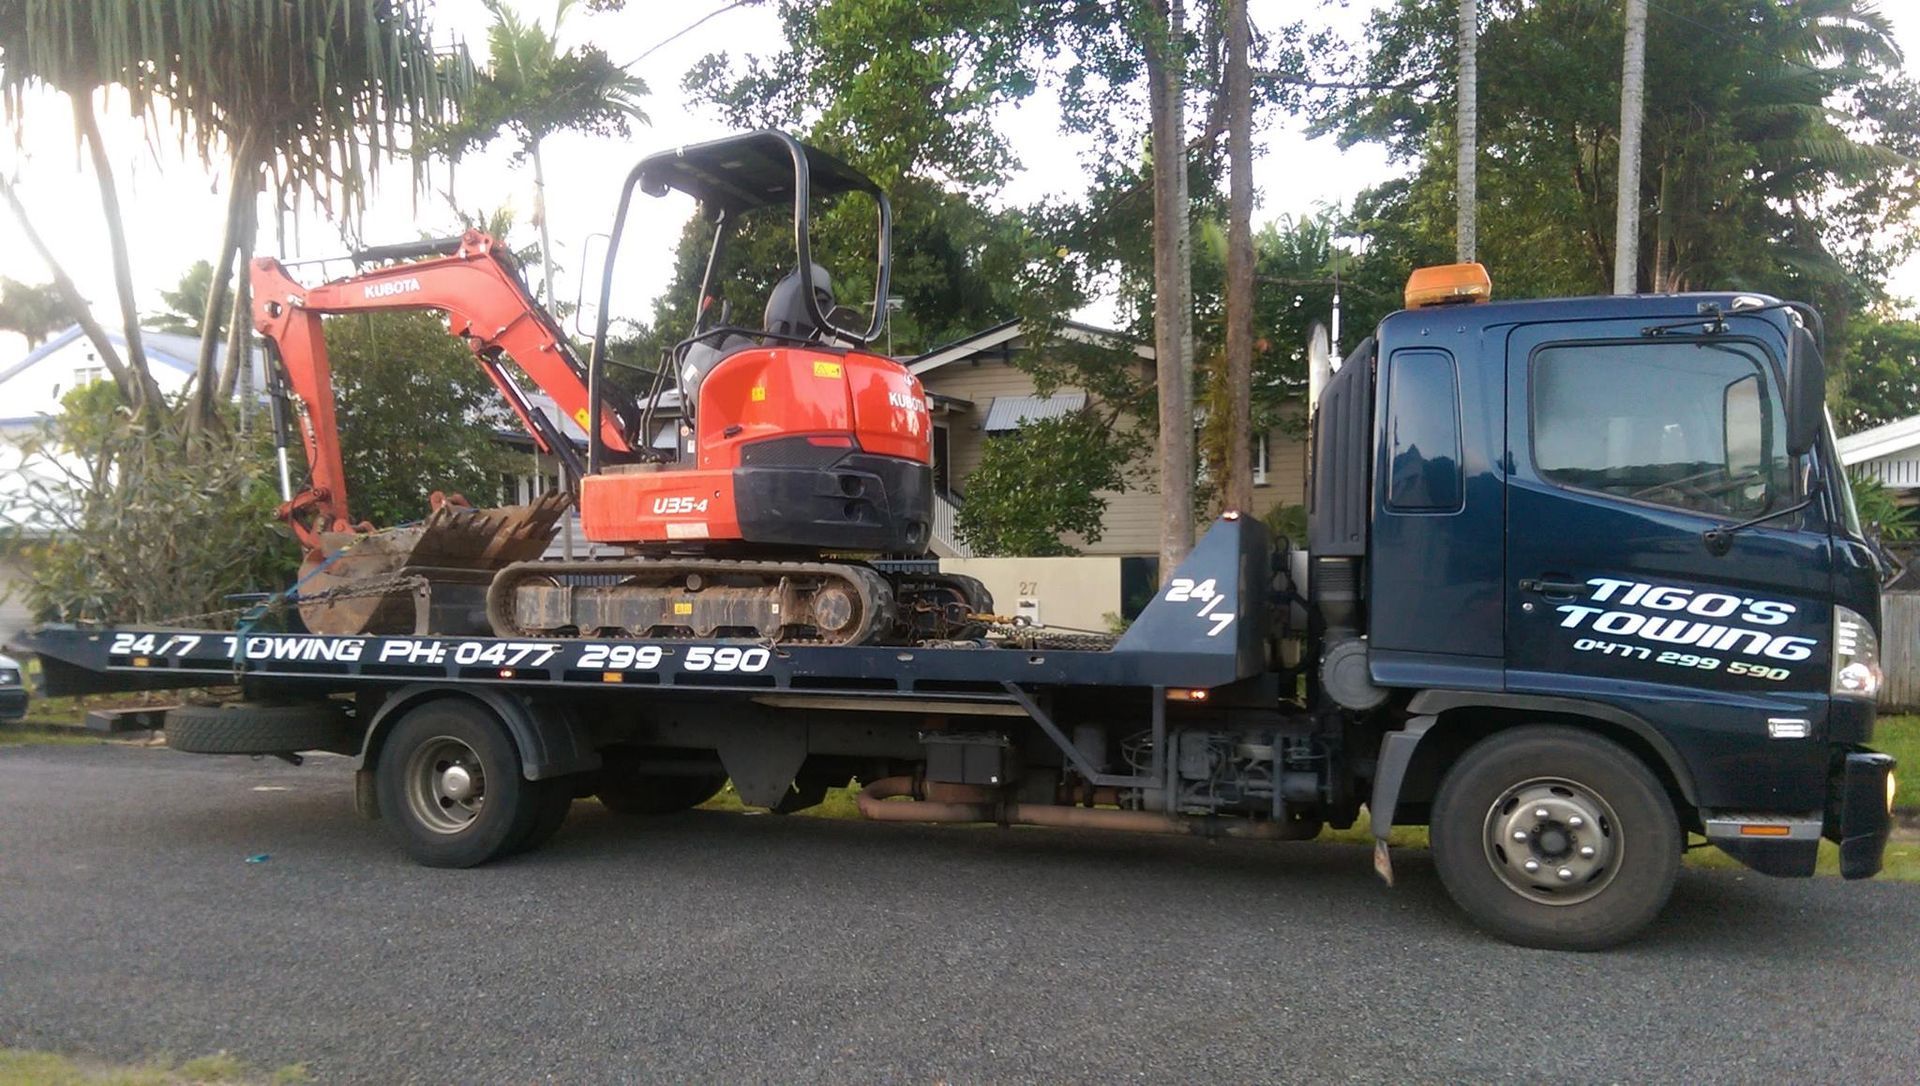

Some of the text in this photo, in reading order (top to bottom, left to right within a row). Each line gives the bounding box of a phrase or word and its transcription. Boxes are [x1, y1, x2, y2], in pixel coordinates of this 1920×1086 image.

[364, 278, 421, 298] KUBOTA
[888, 391, 926, 414] KUBOTA
[653, 496, 709, 514] U35-4
[1019, 581, 1038, 596] 27
[1586, 577, 1797, 626] TIGO'S
[1555, 604, 1818, 661] TOWING
[110, 633, 201, 656] 24/7
[378, 640, 447, 664] PH:
[454, 642, 561, 667] 0477
[576, 645, 663, 670] 299
[683, 646, 770, 672] 590
[1573, 638, 1791, 682] 0477 299 590
